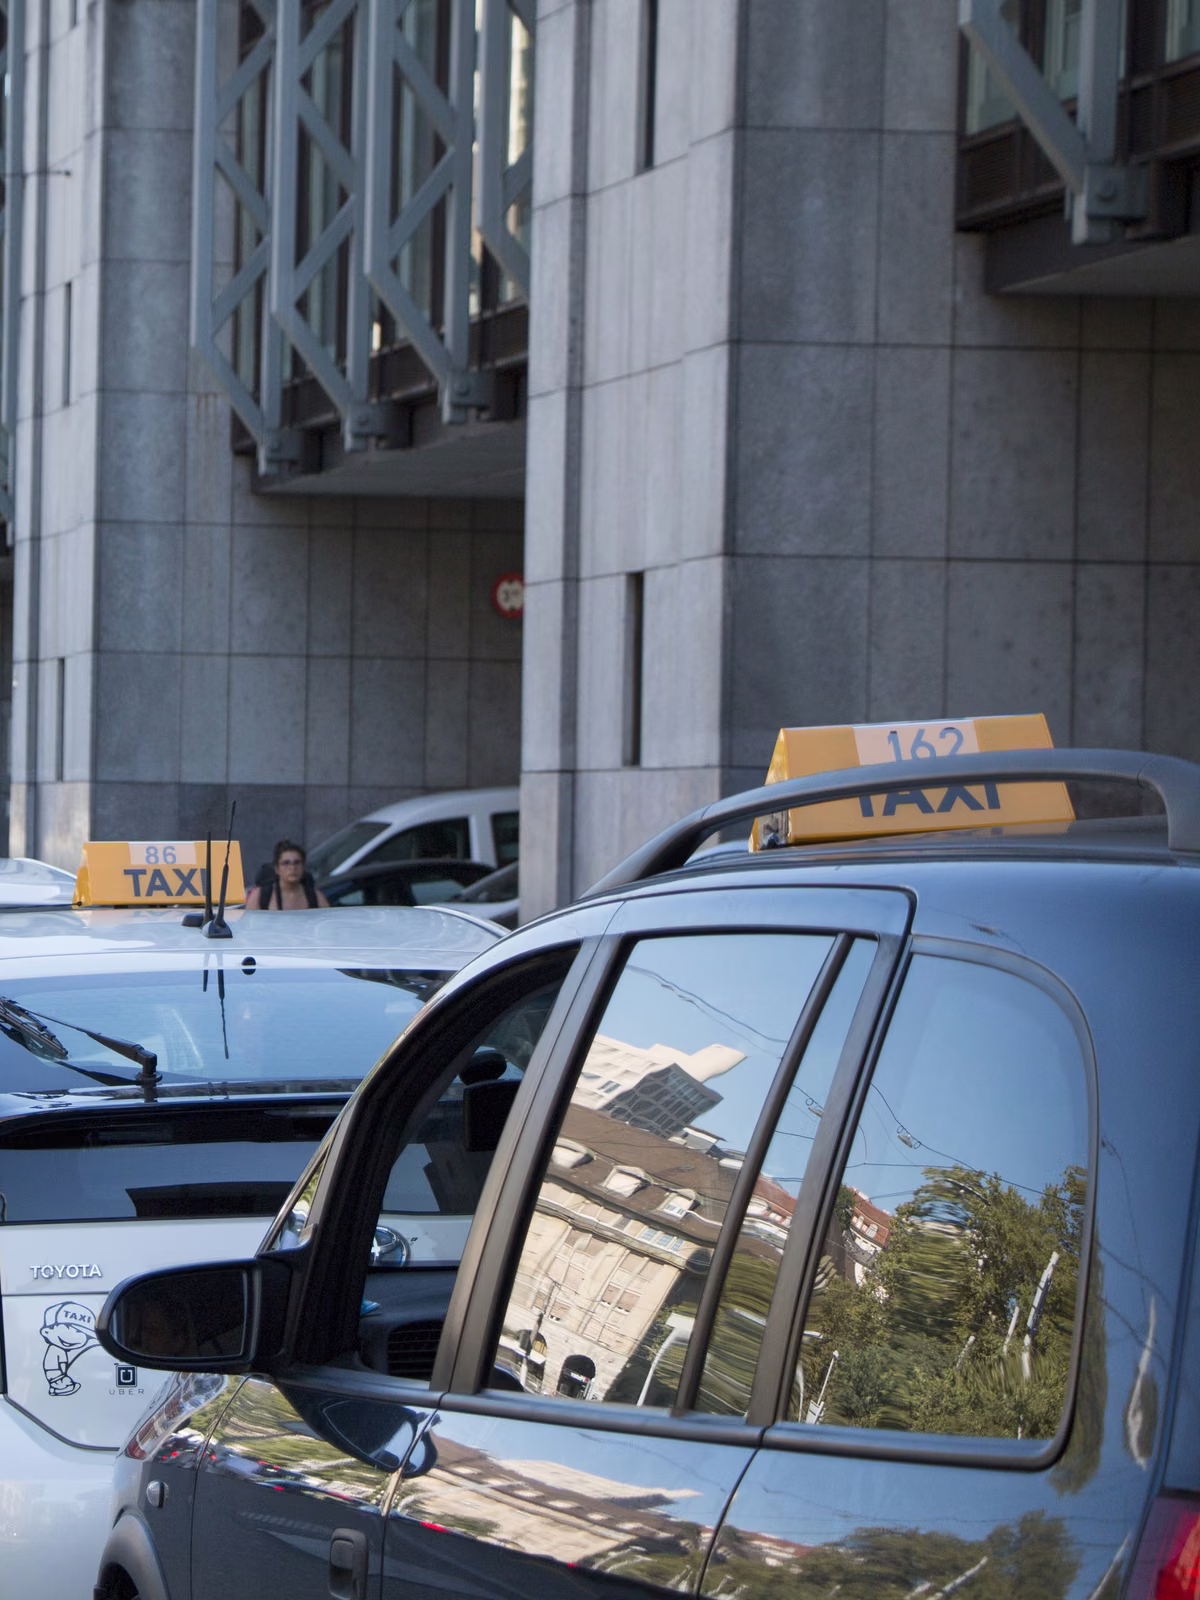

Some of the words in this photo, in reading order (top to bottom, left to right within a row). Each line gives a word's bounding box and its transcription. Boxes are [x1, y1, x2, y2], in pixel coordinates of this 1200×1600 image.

[887, 727, 964, 763] 162
[145, 845, 177, 865] 86
[123, 868, 207, 897] TAXI
[30, 1264, 102, 1280] TOYOTA
[63, 1310, 92, 1324] TAXI
[109, 1388, 145, 1396] UBER
